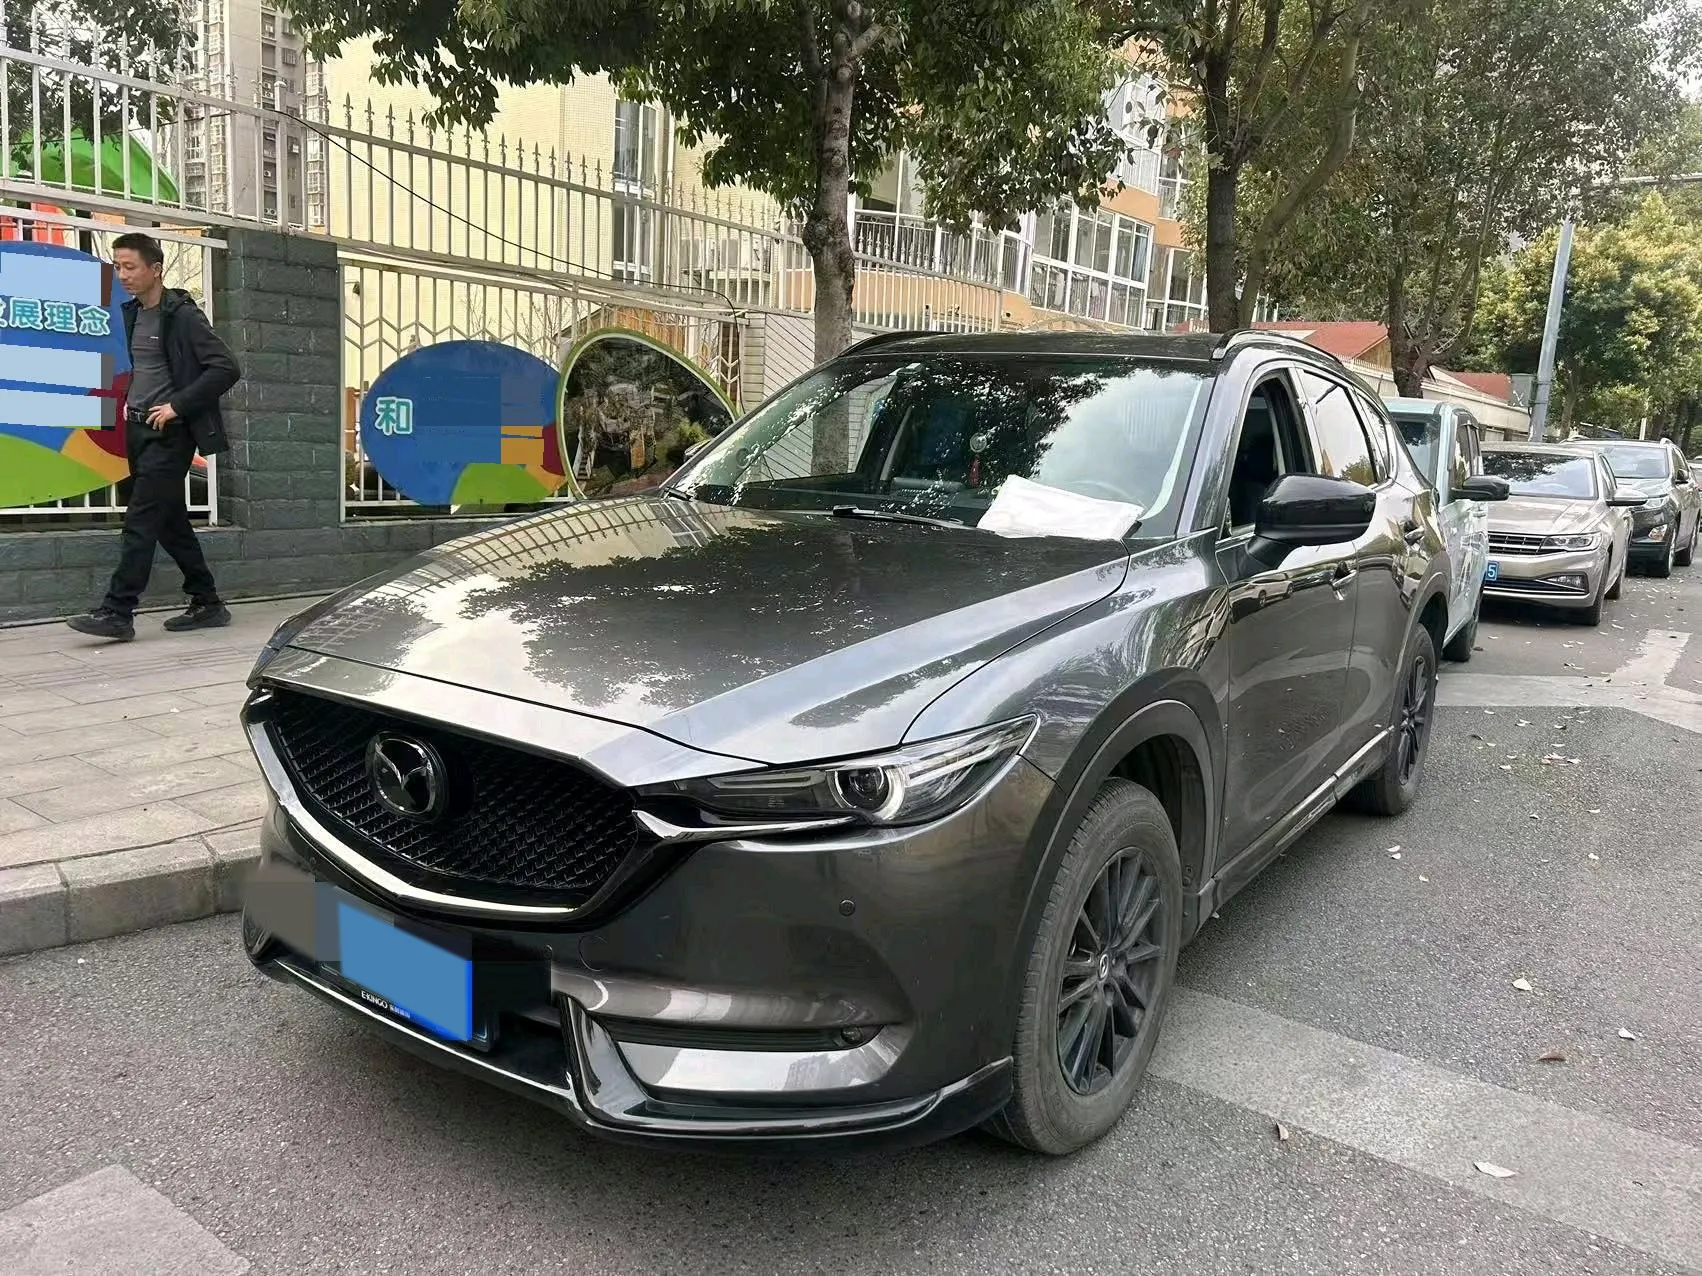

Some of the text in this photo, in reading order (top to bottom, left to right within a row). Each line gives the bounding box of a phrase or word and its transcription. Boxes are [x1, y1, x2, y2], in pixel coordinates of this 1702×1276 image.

[0, 297, 110, 336] 展理念
[374, 396, 413, 436] 和
